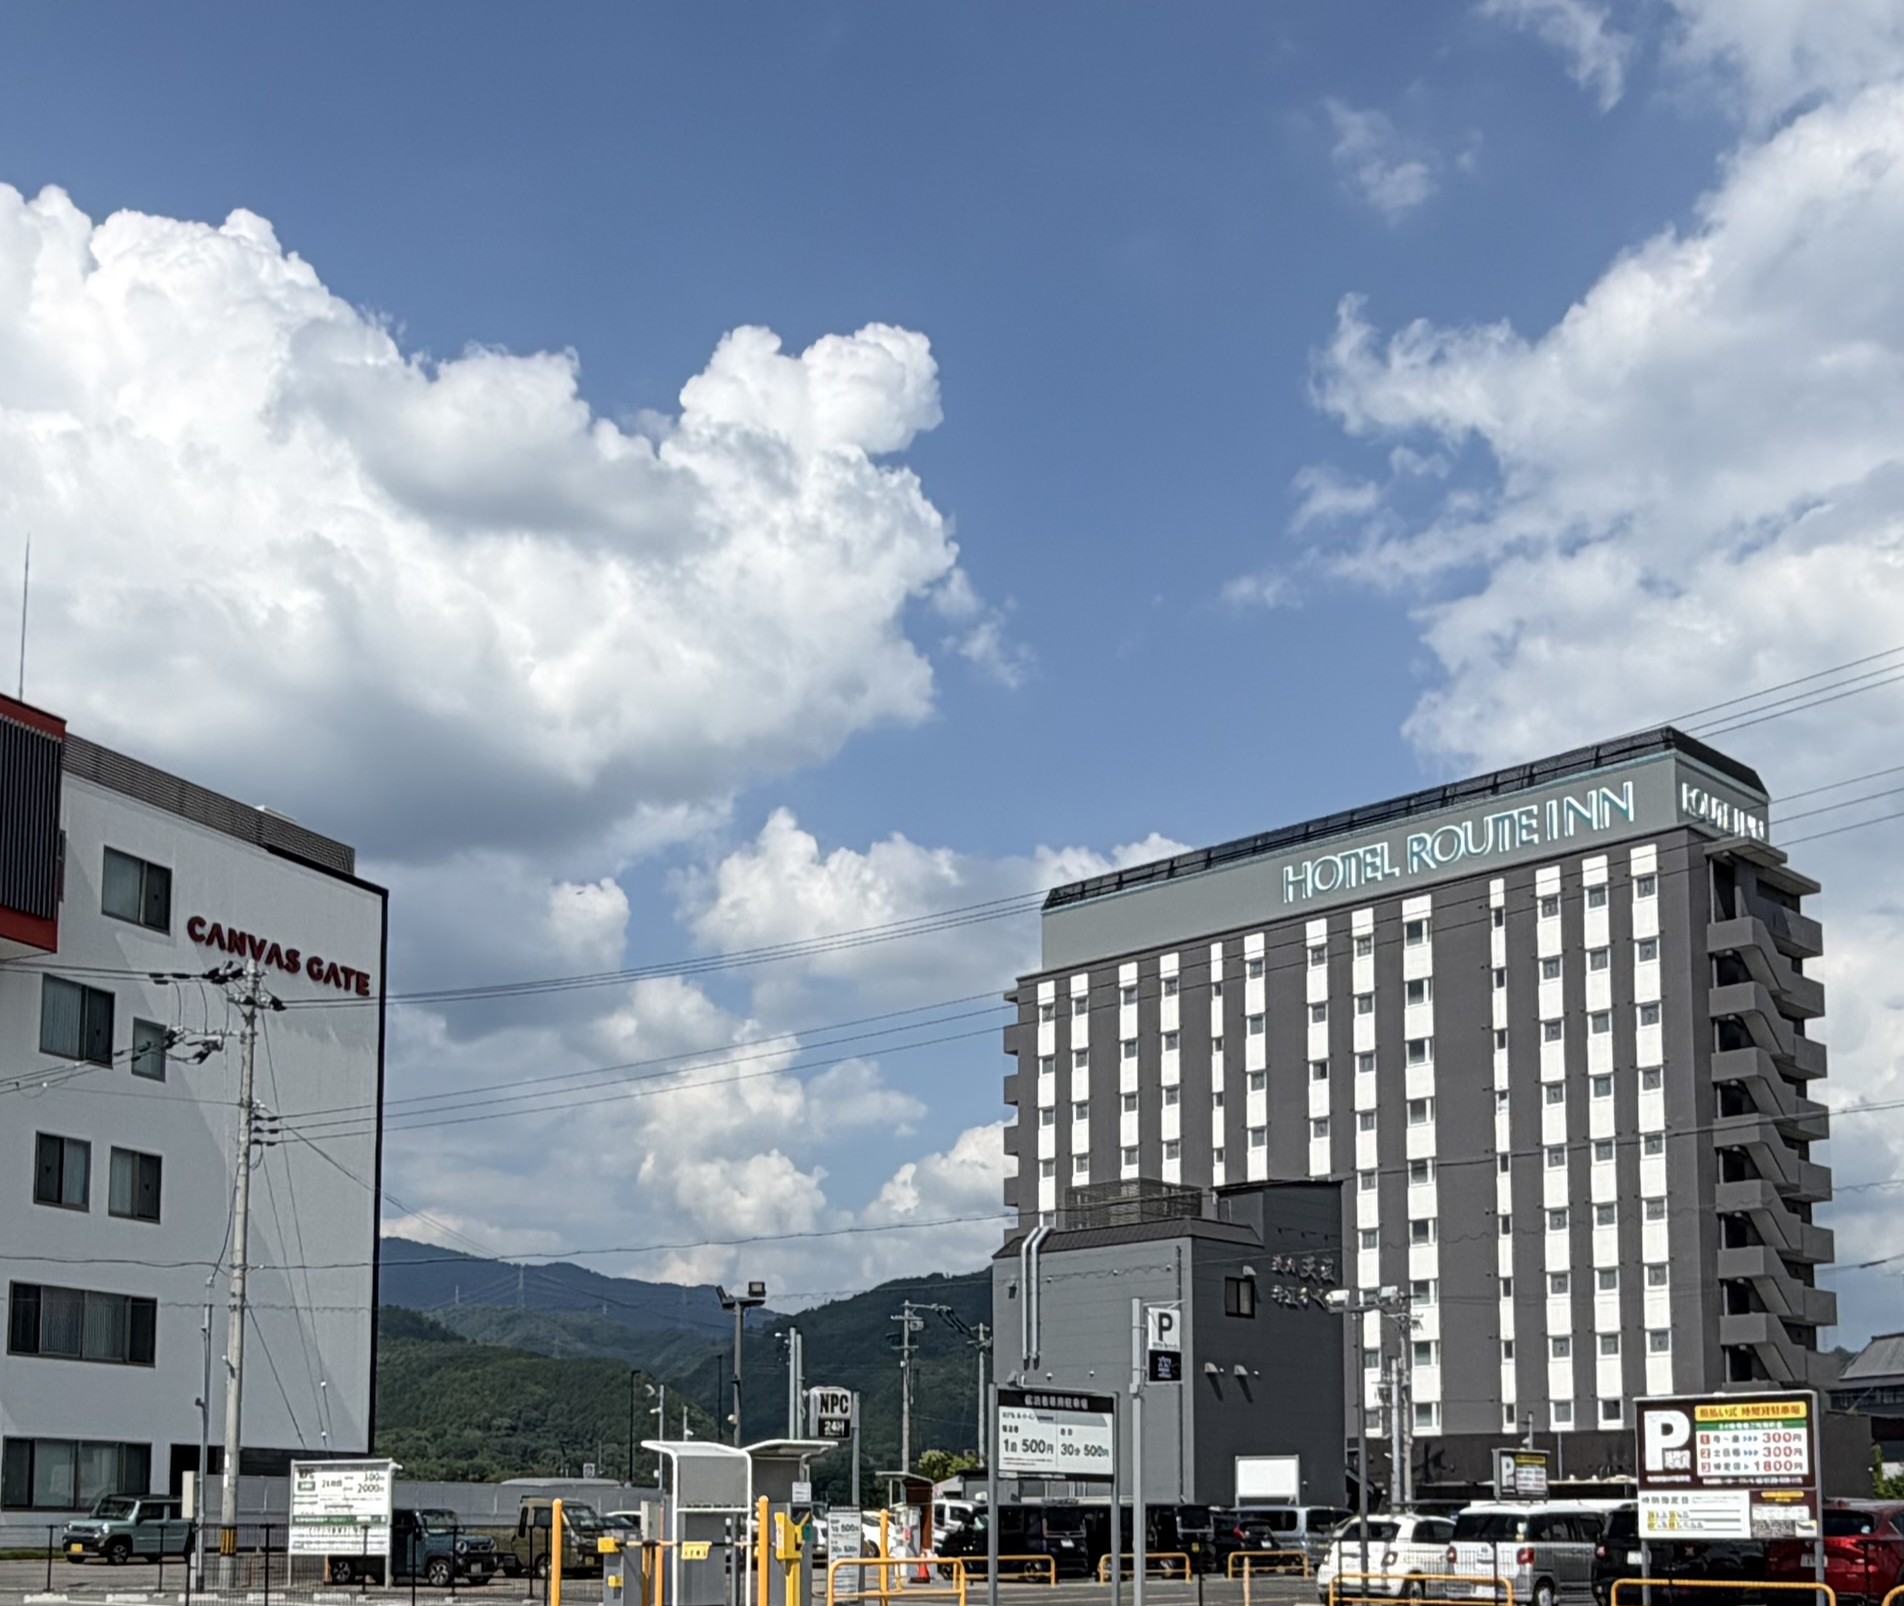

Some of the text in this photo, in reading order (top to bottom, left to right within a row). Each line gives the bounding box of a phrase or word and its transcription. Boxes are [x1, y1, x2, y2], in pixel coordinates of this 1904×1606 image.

[1283, 781, 1634, 903] HOTEL ROUTE INN
[187, 916, 371, 996] CANVAS GATE
[1158, 1312, 1173, 1341] P
[819, 1393, 849, 1414] NPC
[824, 1420, 845, 1433] 24H
[1644, 1410, 1690, 1471] P
[1501, 1456, 1514, 1486] P
